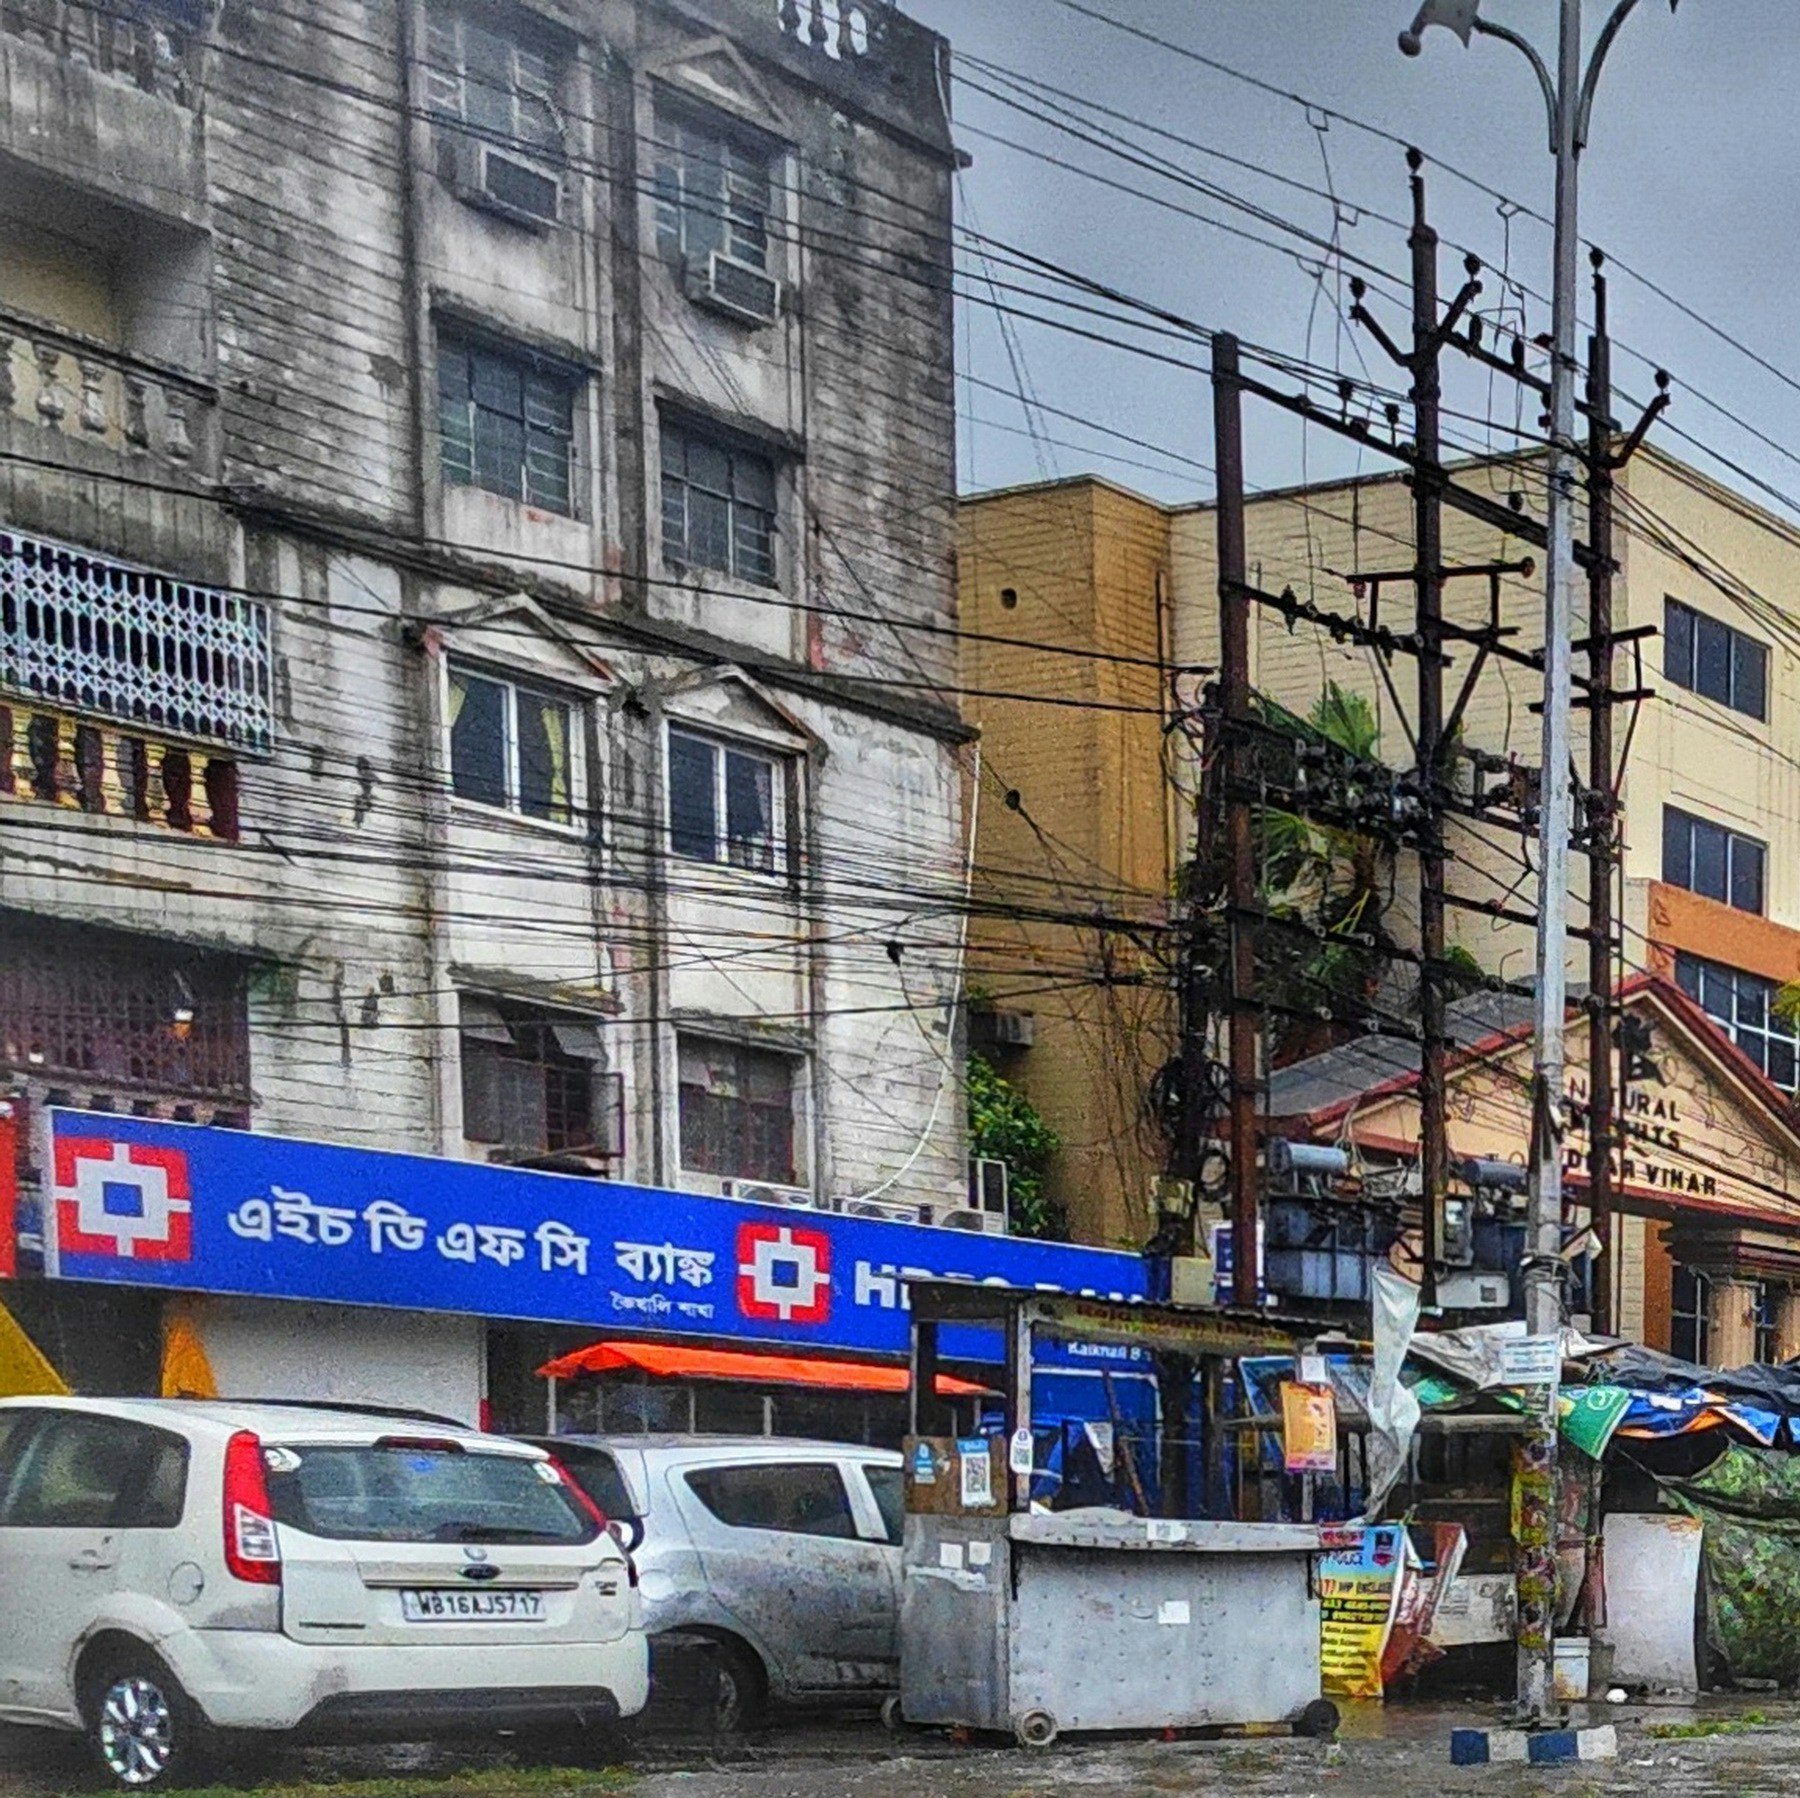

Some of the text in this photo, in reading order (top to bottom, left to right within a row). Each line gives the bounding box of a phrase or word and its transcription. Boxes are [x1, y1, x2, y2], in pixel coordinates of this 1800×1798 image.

[1646, 1162, 1717, 1196] VIHAR
[227, 1184, 716, 1289] এইচ ডি এফ সি ব্যাঙ্ক
